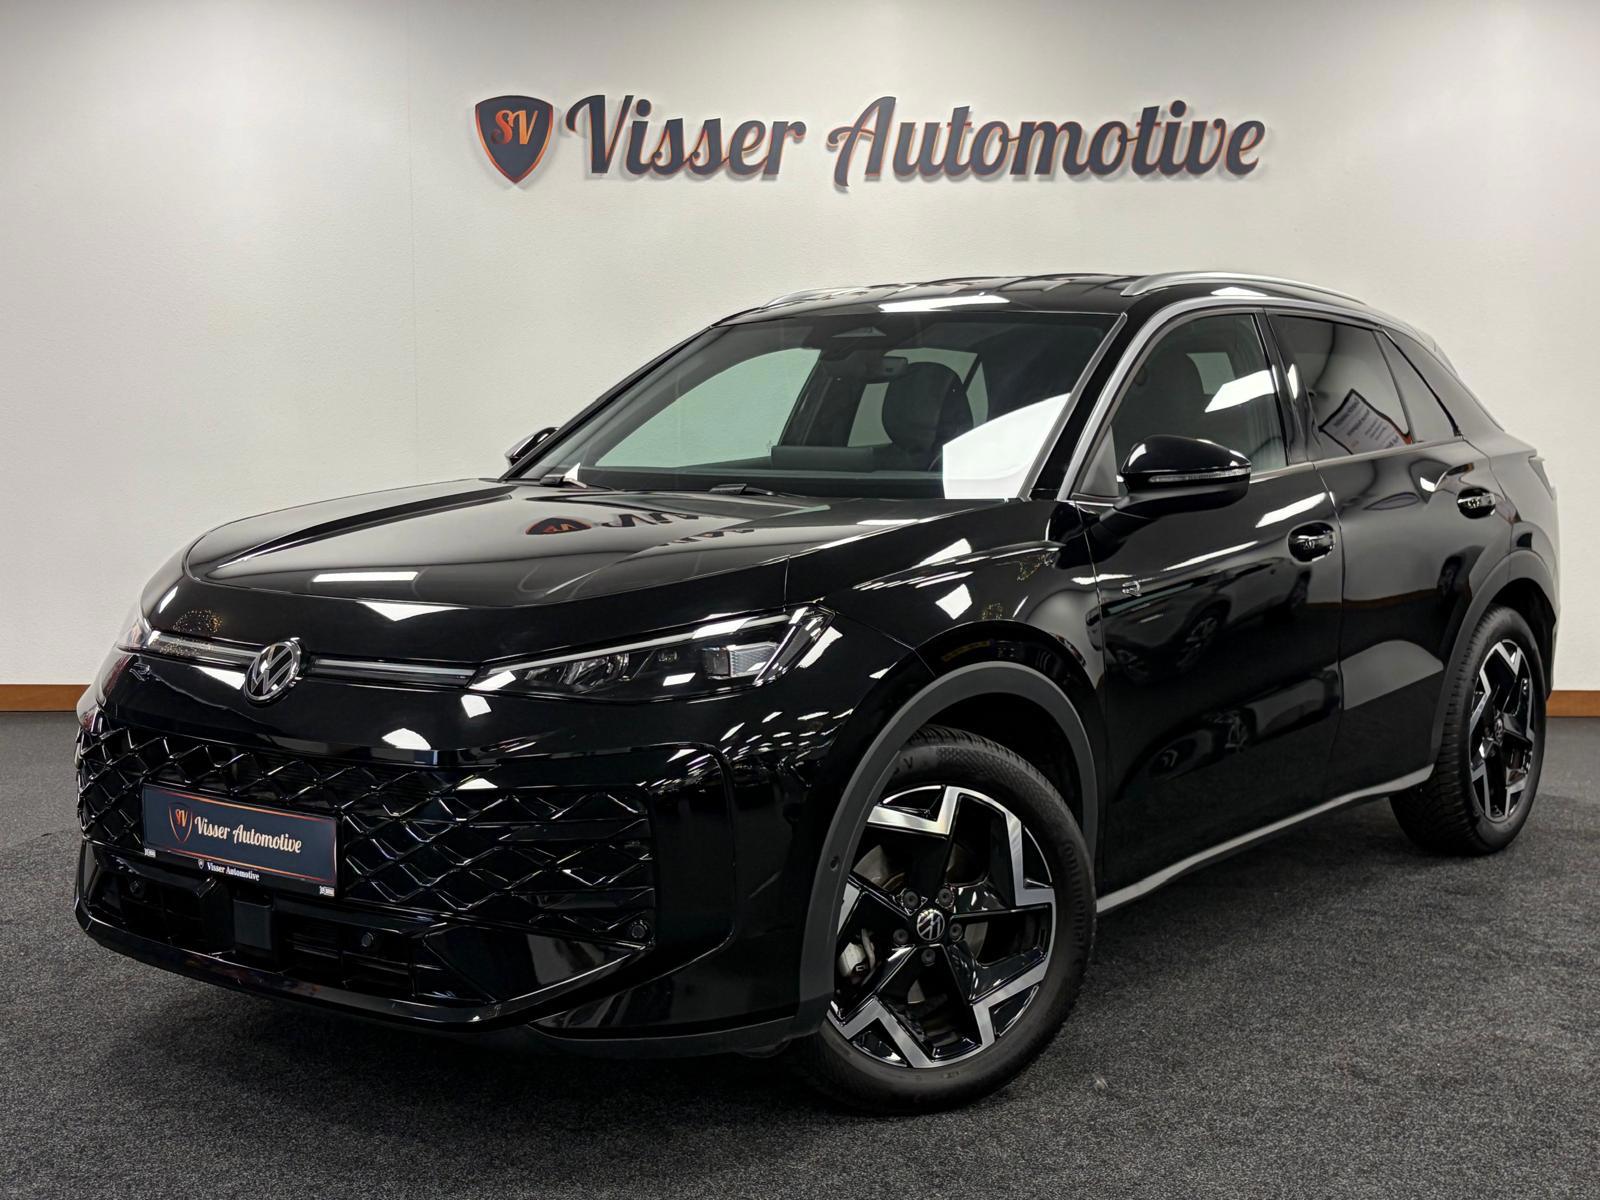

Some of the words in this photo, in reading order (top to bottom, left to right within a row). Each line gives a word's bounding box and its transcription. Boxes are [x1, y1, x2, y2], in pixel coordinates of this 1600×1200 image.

[490, 109, 538, 146] SV
[566, 94, 806, 176] Visser
[827, 96, 1266, 187] Automotive
[195, 816, 230, 840] Visser
[232, 824, 302, 854] Automotive
[206, 862, 226, 874] Visser
[226, 866, 260, 882] Automotive
